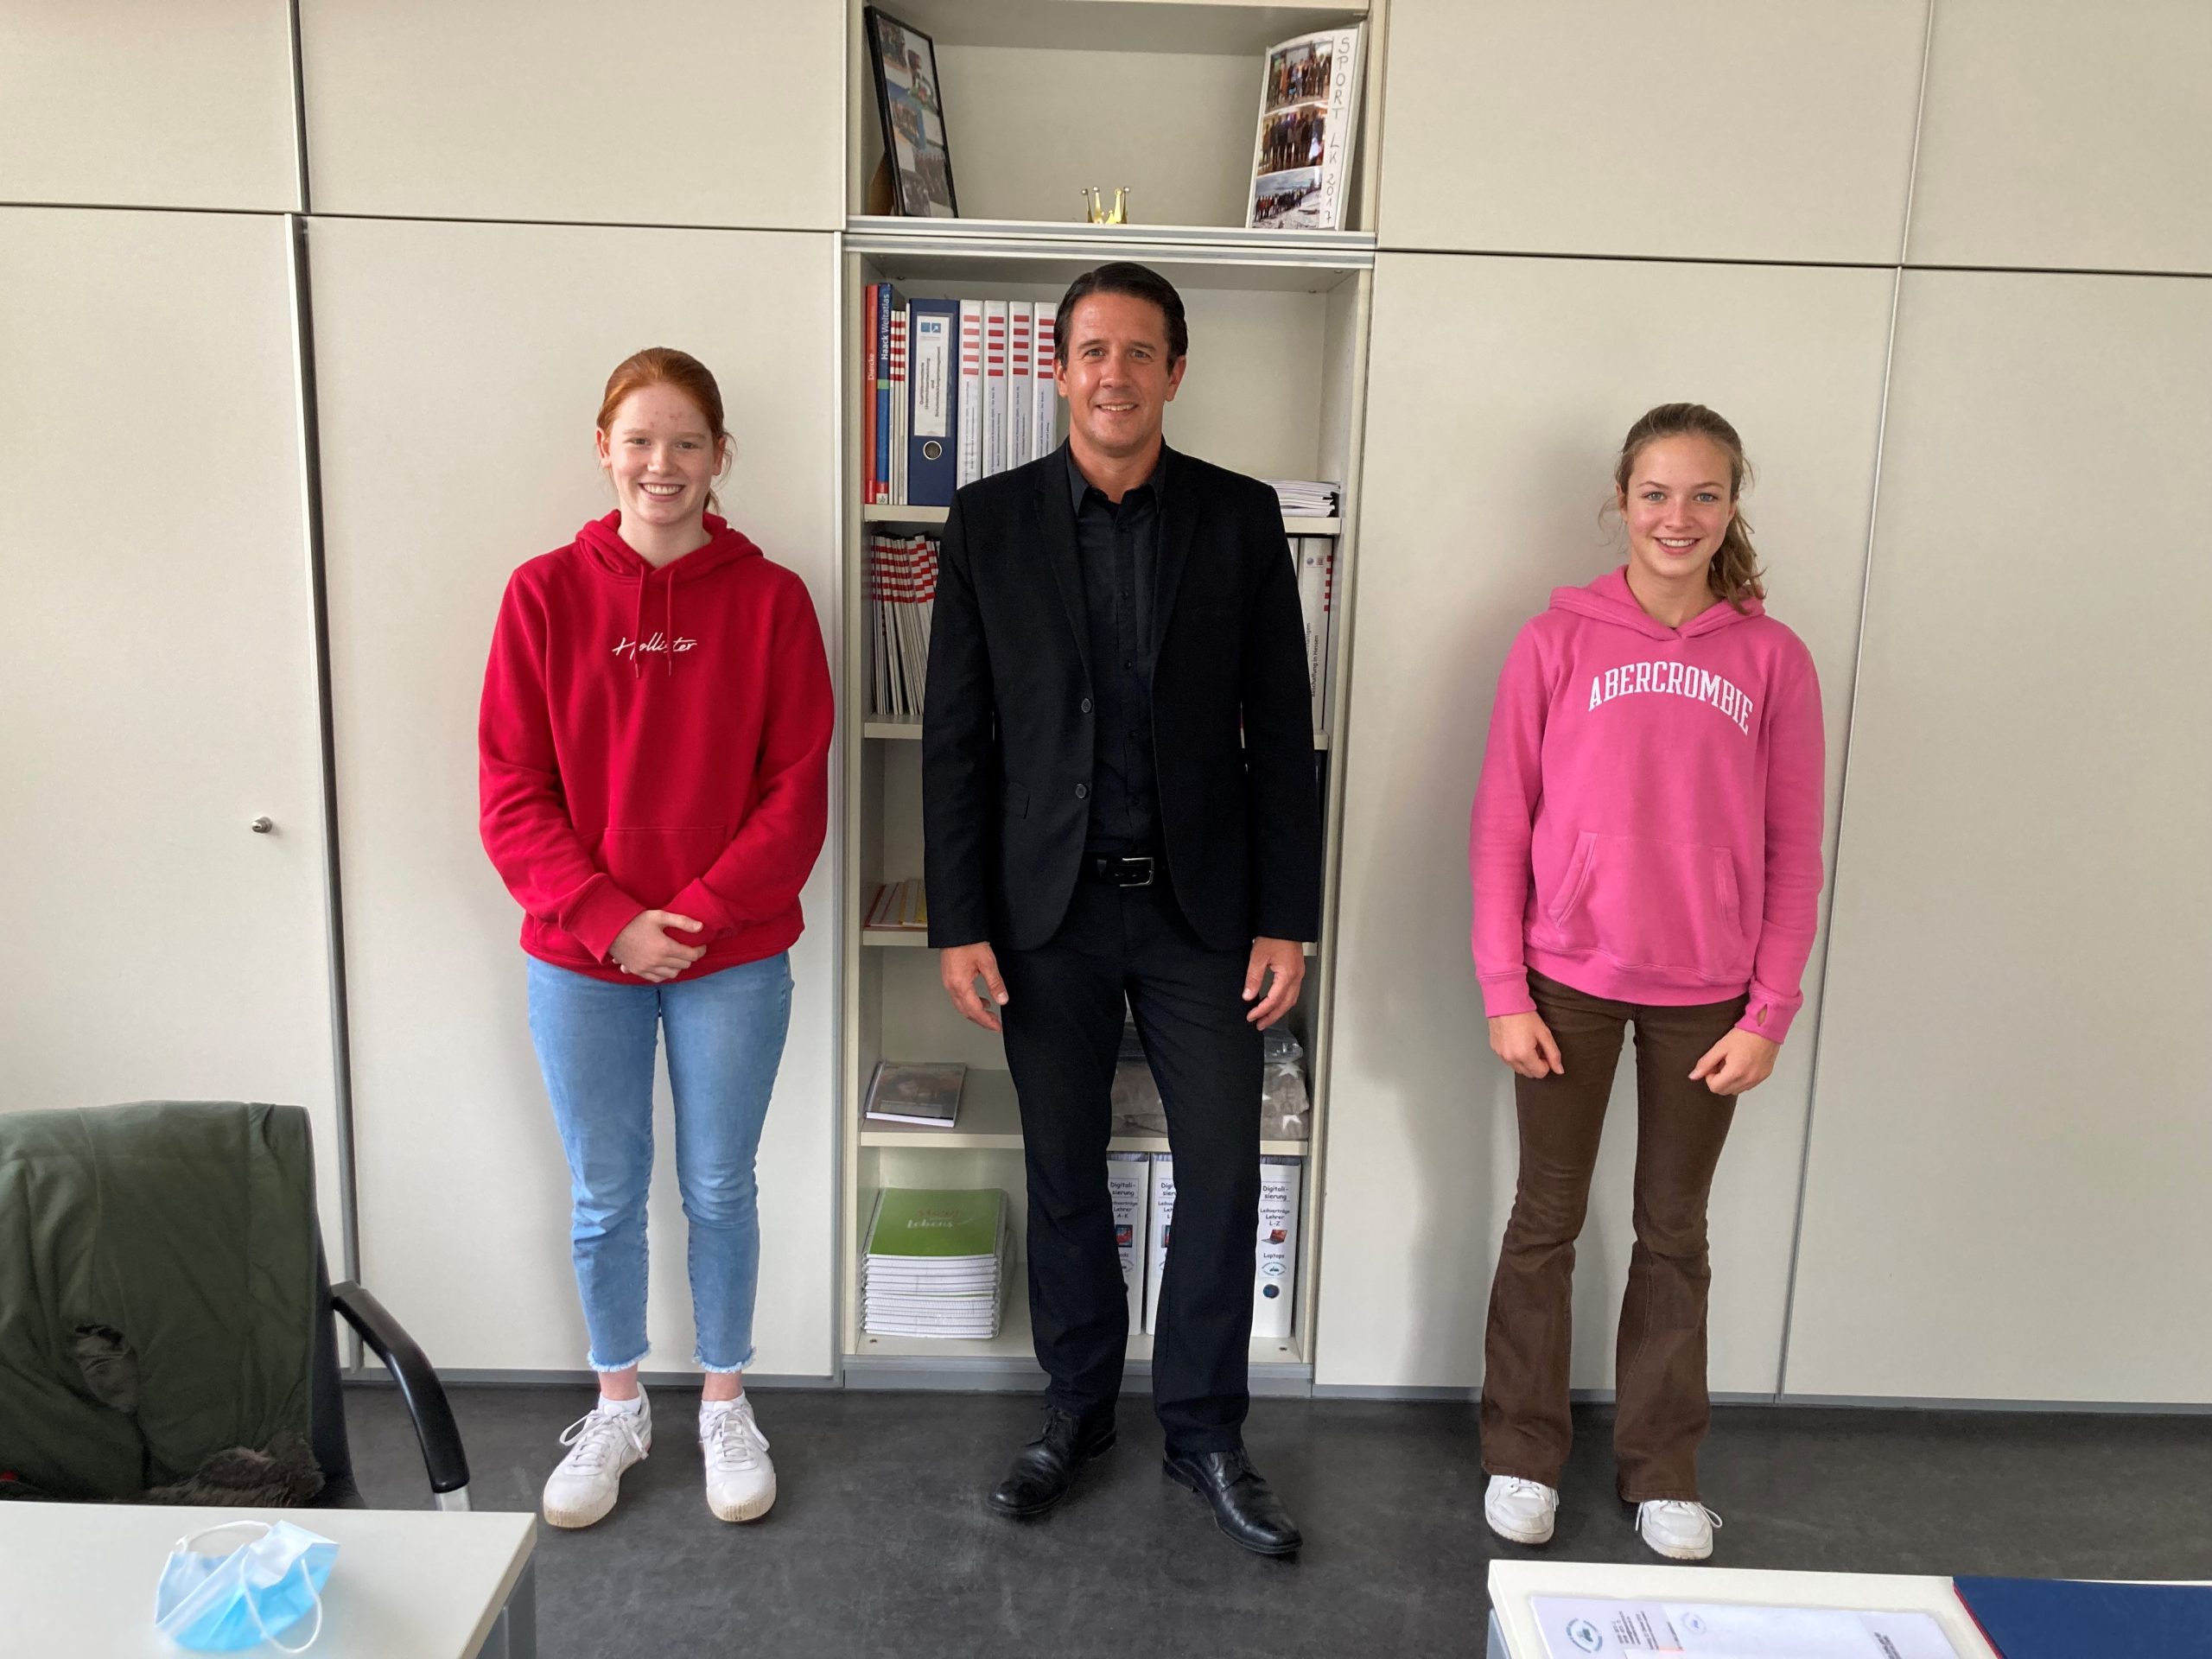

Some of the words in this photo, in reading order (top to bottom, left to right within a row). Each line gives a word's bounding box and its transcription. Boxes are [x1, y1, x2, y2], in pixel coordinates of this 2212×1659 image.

[1332, 37, 1350, 119] SPORT
[1329, 132, 1339, 163] LK
[1324, 174, 1336, 223] 2017
[880, 294, 891, 333] Weltatlas
[880, 334, 889, 360] Haack
[612, 632, 697, 660] Hollister
[1588, 661, 1753, 736] ABERCROMBIE
[1110, 1182, 1135, 1191] Digitali-
